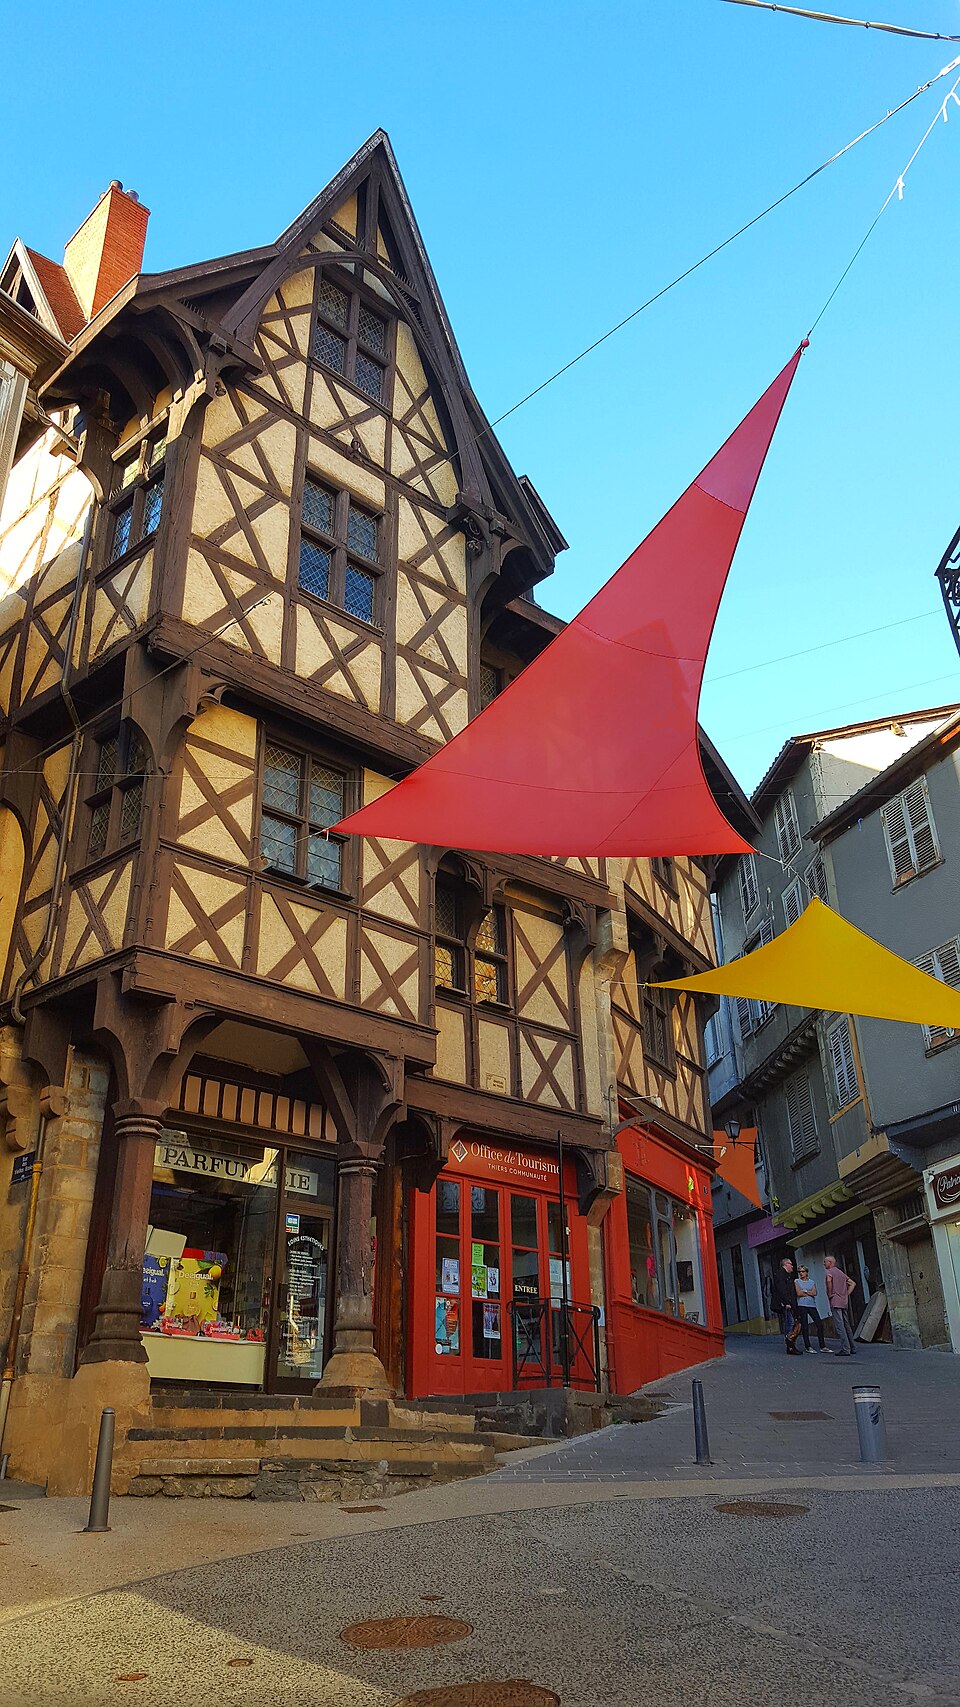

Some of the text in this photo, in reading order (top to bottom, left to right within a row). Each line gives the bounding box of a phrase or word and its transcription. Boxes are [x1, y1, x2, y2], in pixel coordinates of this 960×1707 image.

[471, 1142, 503, 1162] Office
[504, 1150, 515, 1164] de
[487, 1163, 547, 1181] THIERS COMMUNAUTÉ
